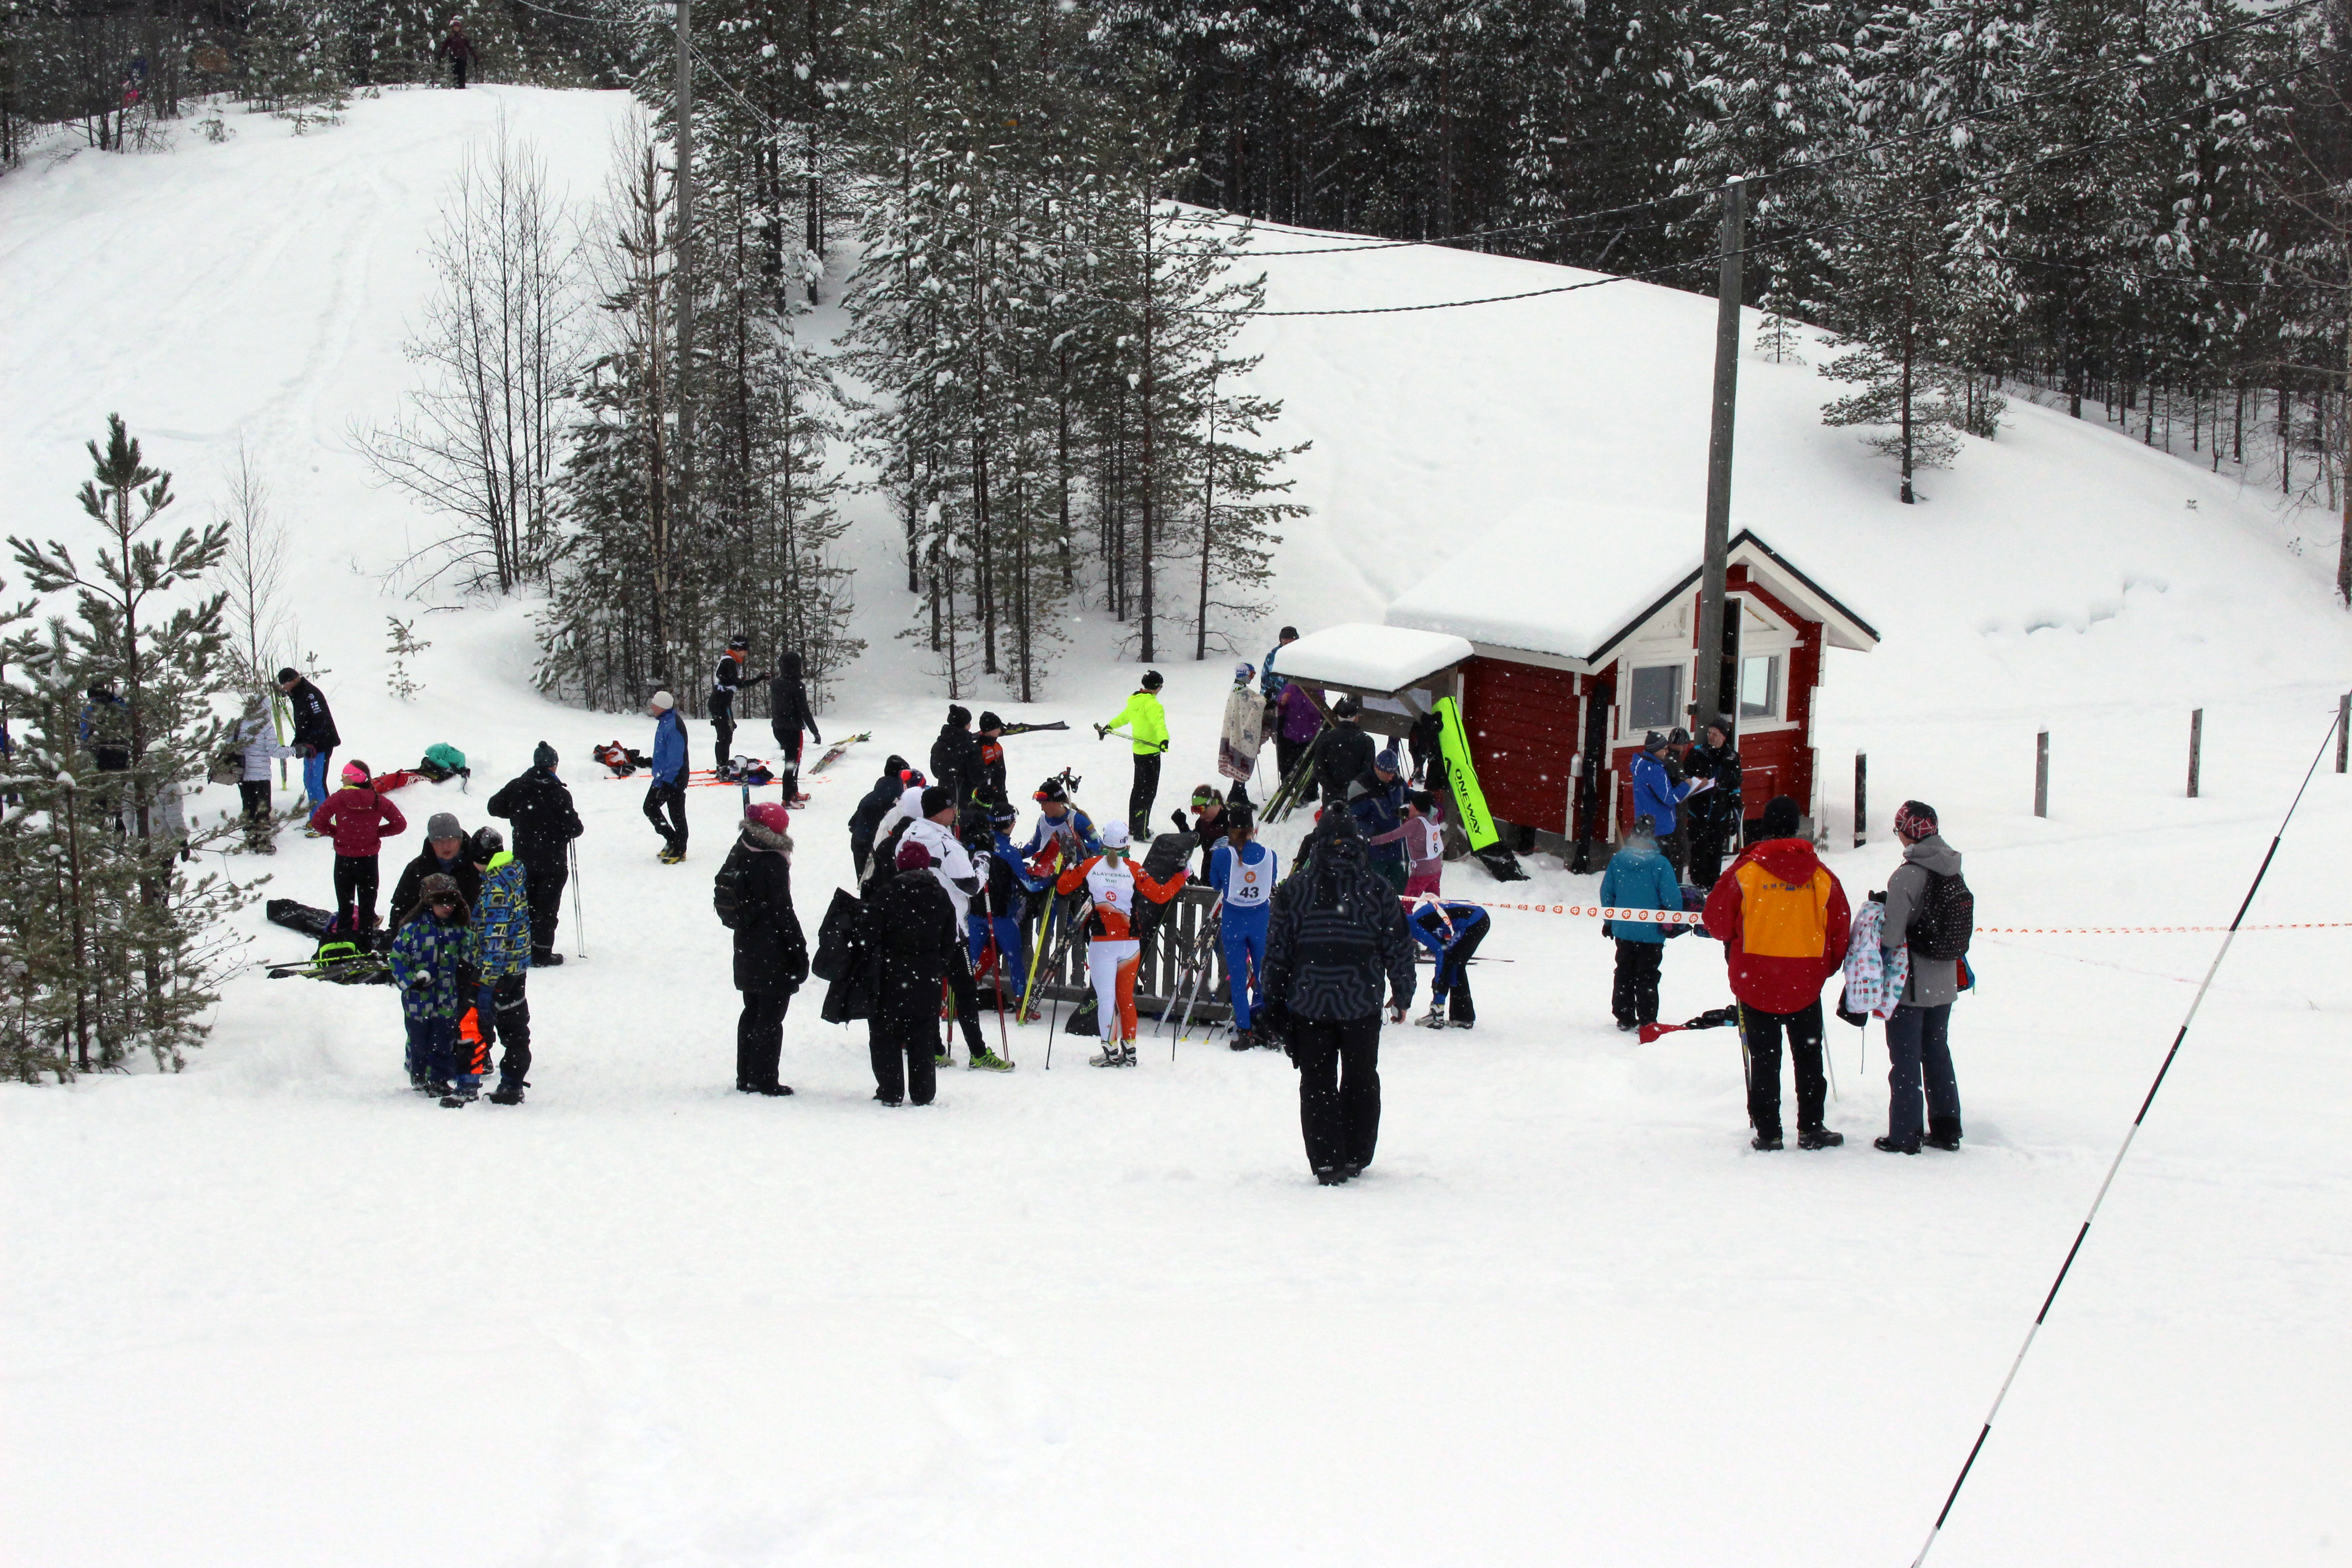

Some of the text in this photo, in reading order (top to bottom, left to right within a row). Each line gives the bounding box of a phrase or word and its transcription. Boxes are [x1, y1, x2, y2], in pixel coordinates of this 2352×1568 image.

[1455, 769, 1470, 802] ONE
[1466, 803, 1482, 835] WAY
[1434, 843, 1438, 853] 6
[1240, 887, 1259, 898] 43
